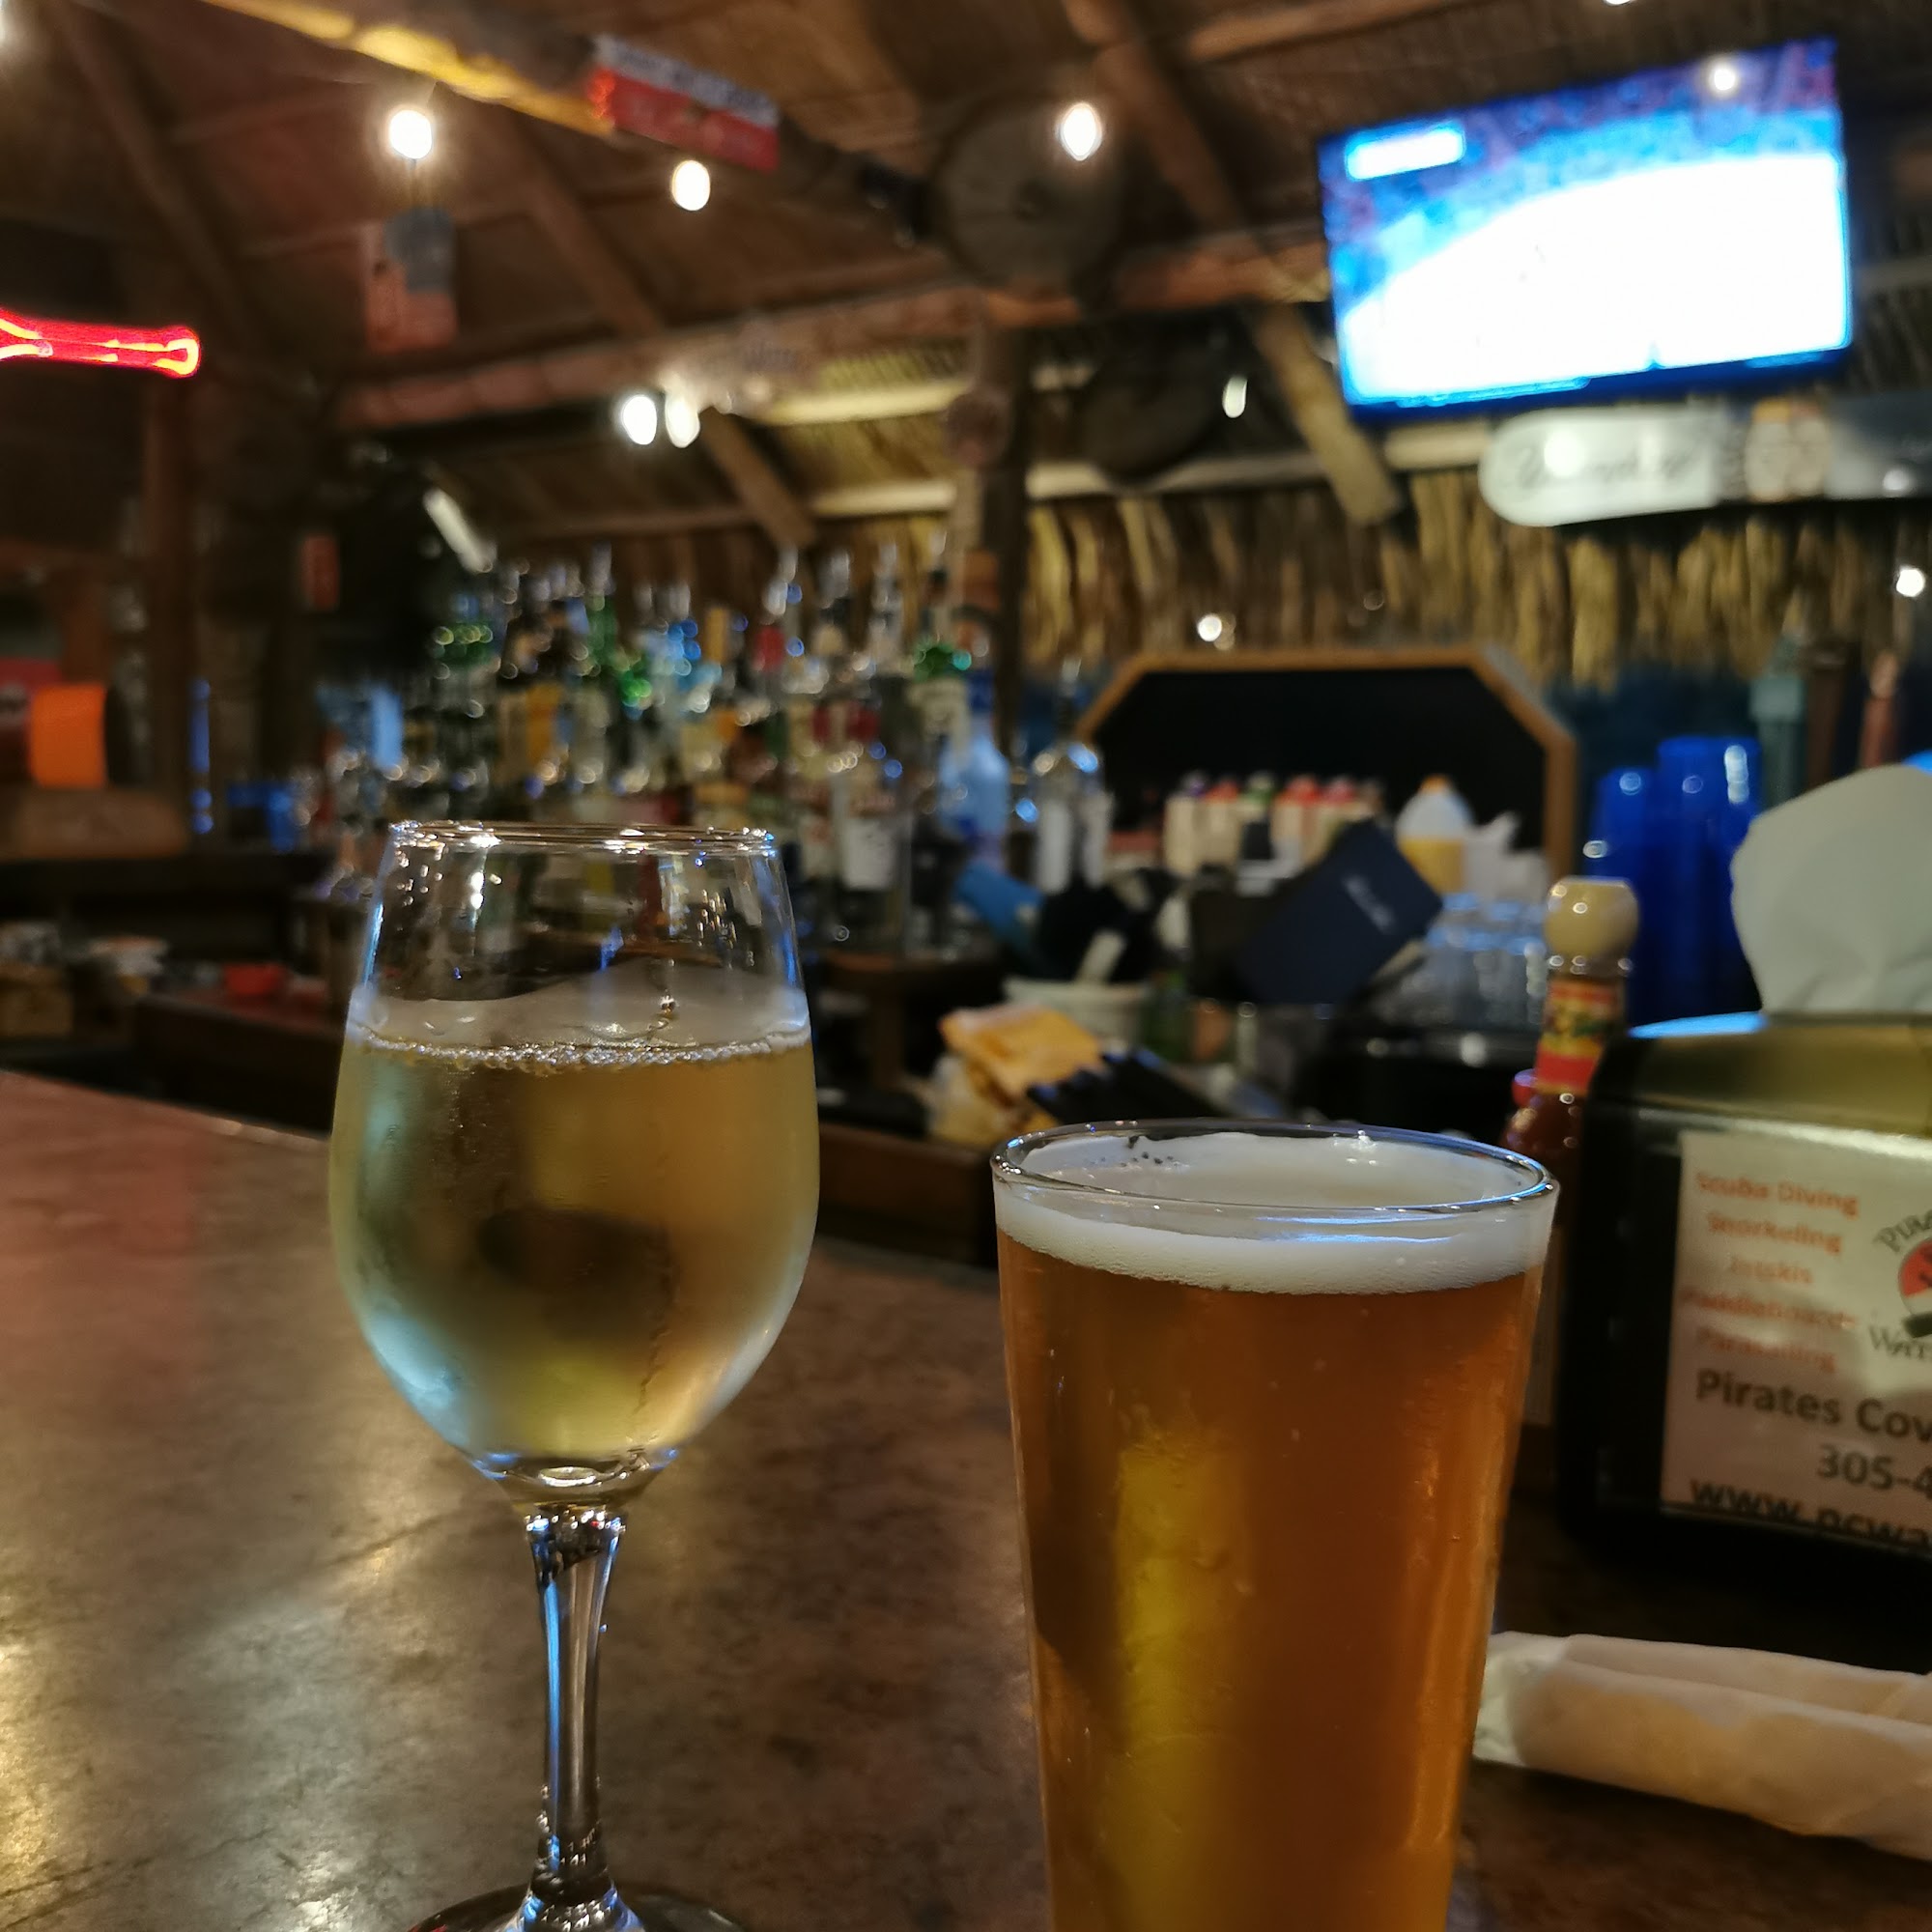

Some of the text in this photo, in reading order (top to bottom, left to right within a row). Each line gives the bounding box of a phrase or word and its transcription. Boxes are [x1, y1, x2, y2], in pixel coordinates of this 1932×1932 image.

[1697, 1173, 1858, 1219] Scuba Diving
[1697, 1369, 1841, 1425] Pirates
